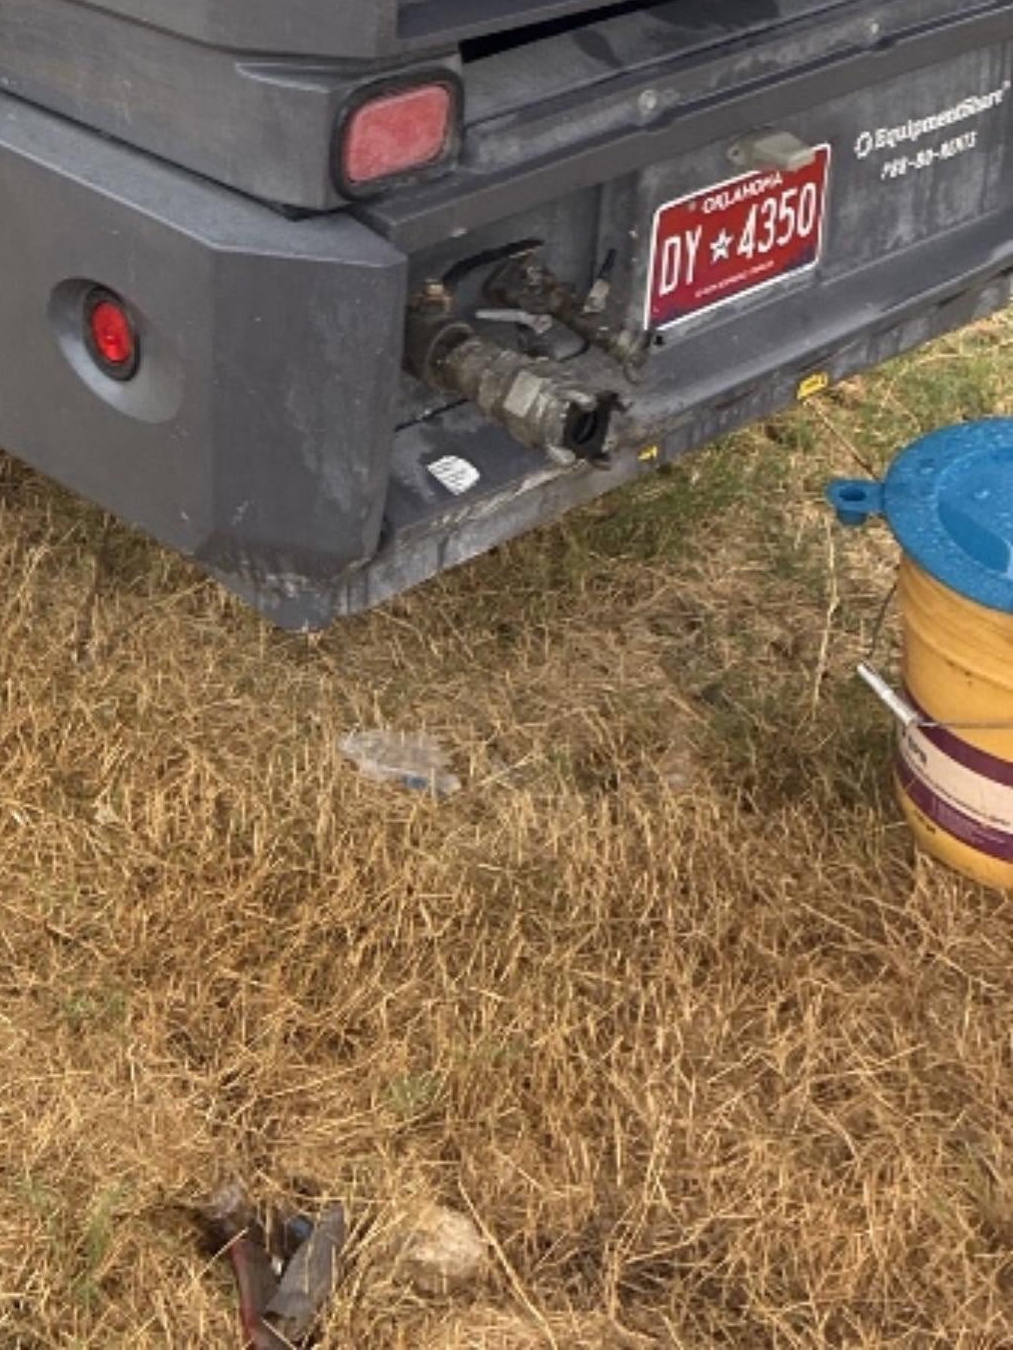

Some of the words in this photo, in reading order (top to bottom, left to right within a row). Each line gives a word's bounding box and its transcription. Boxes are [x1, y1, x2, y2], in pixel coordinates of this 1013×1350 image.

[702, 171, 784, 214] OKLAHOMA
[659, 224, 702, 297] DY
[737, 182, 817, 259] 4350
